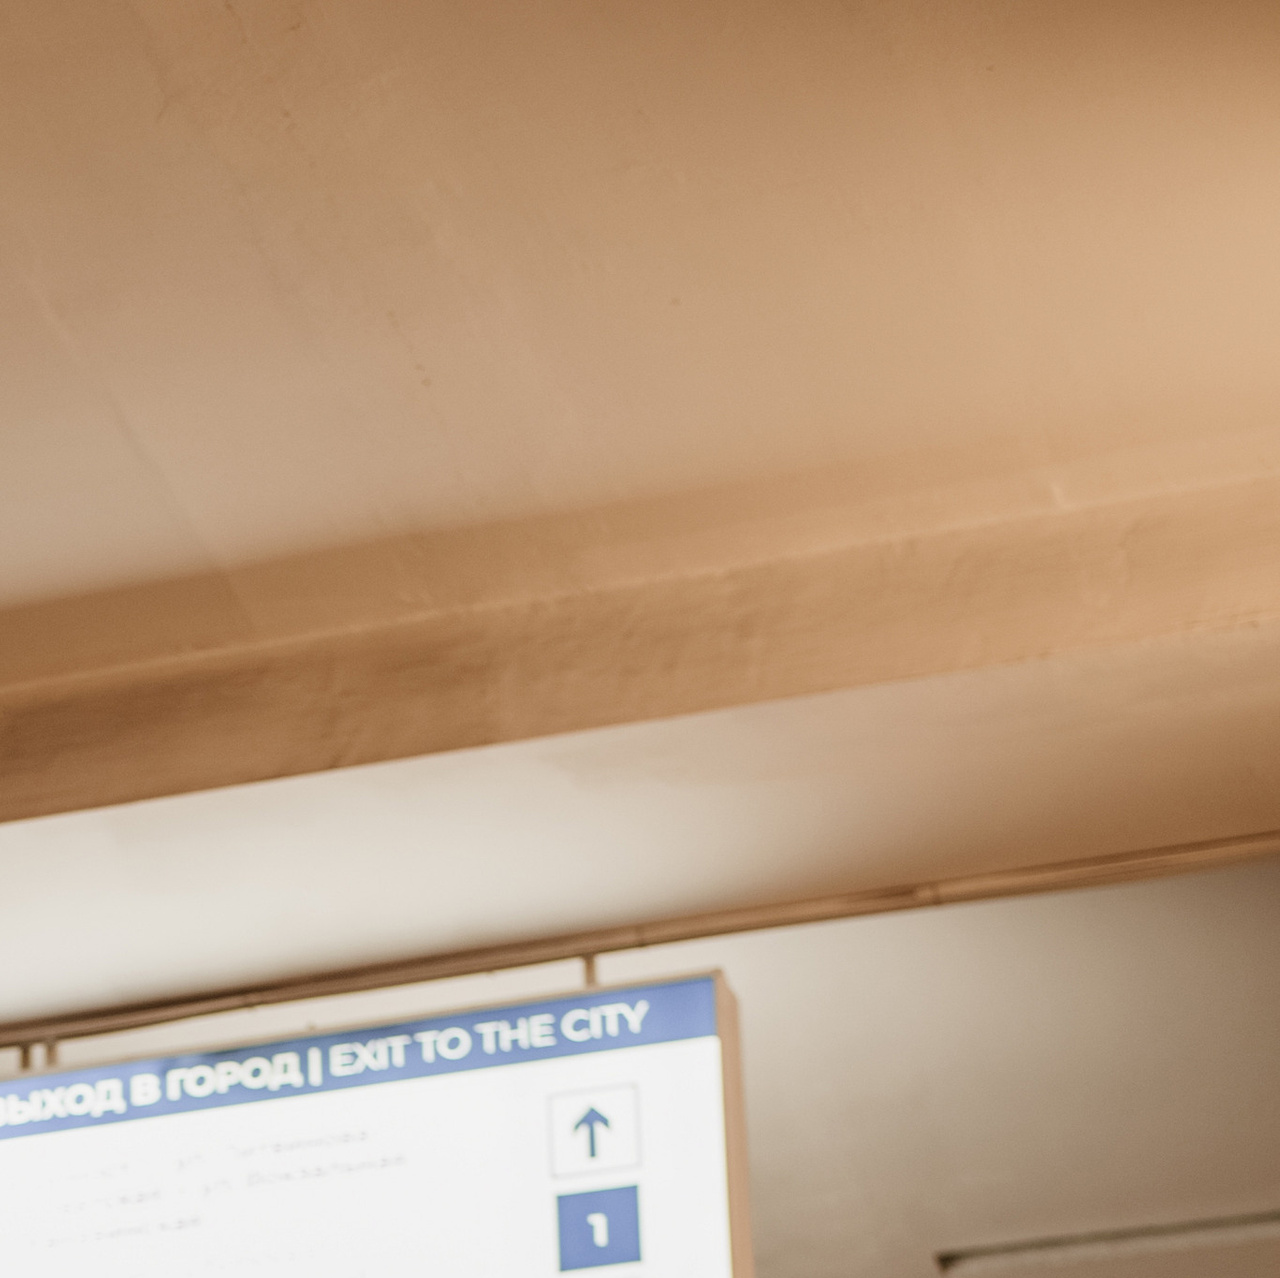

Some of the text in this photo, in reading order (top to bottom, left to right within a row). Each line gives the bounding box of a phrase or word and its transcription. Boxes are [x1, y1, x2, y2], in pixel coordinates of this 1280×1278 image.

[130, 1073, 162, 1107] В
[166, 1051, 305, 1101] ГОРОД
[328, 1034, 412, 1077] EXIT
[413, 1027, 472, 1063] TO
[473, 1013, 557, 1055] THE
[560, 999, 650, 1042] CITY
[586, 1212, 609, 1248] 1
